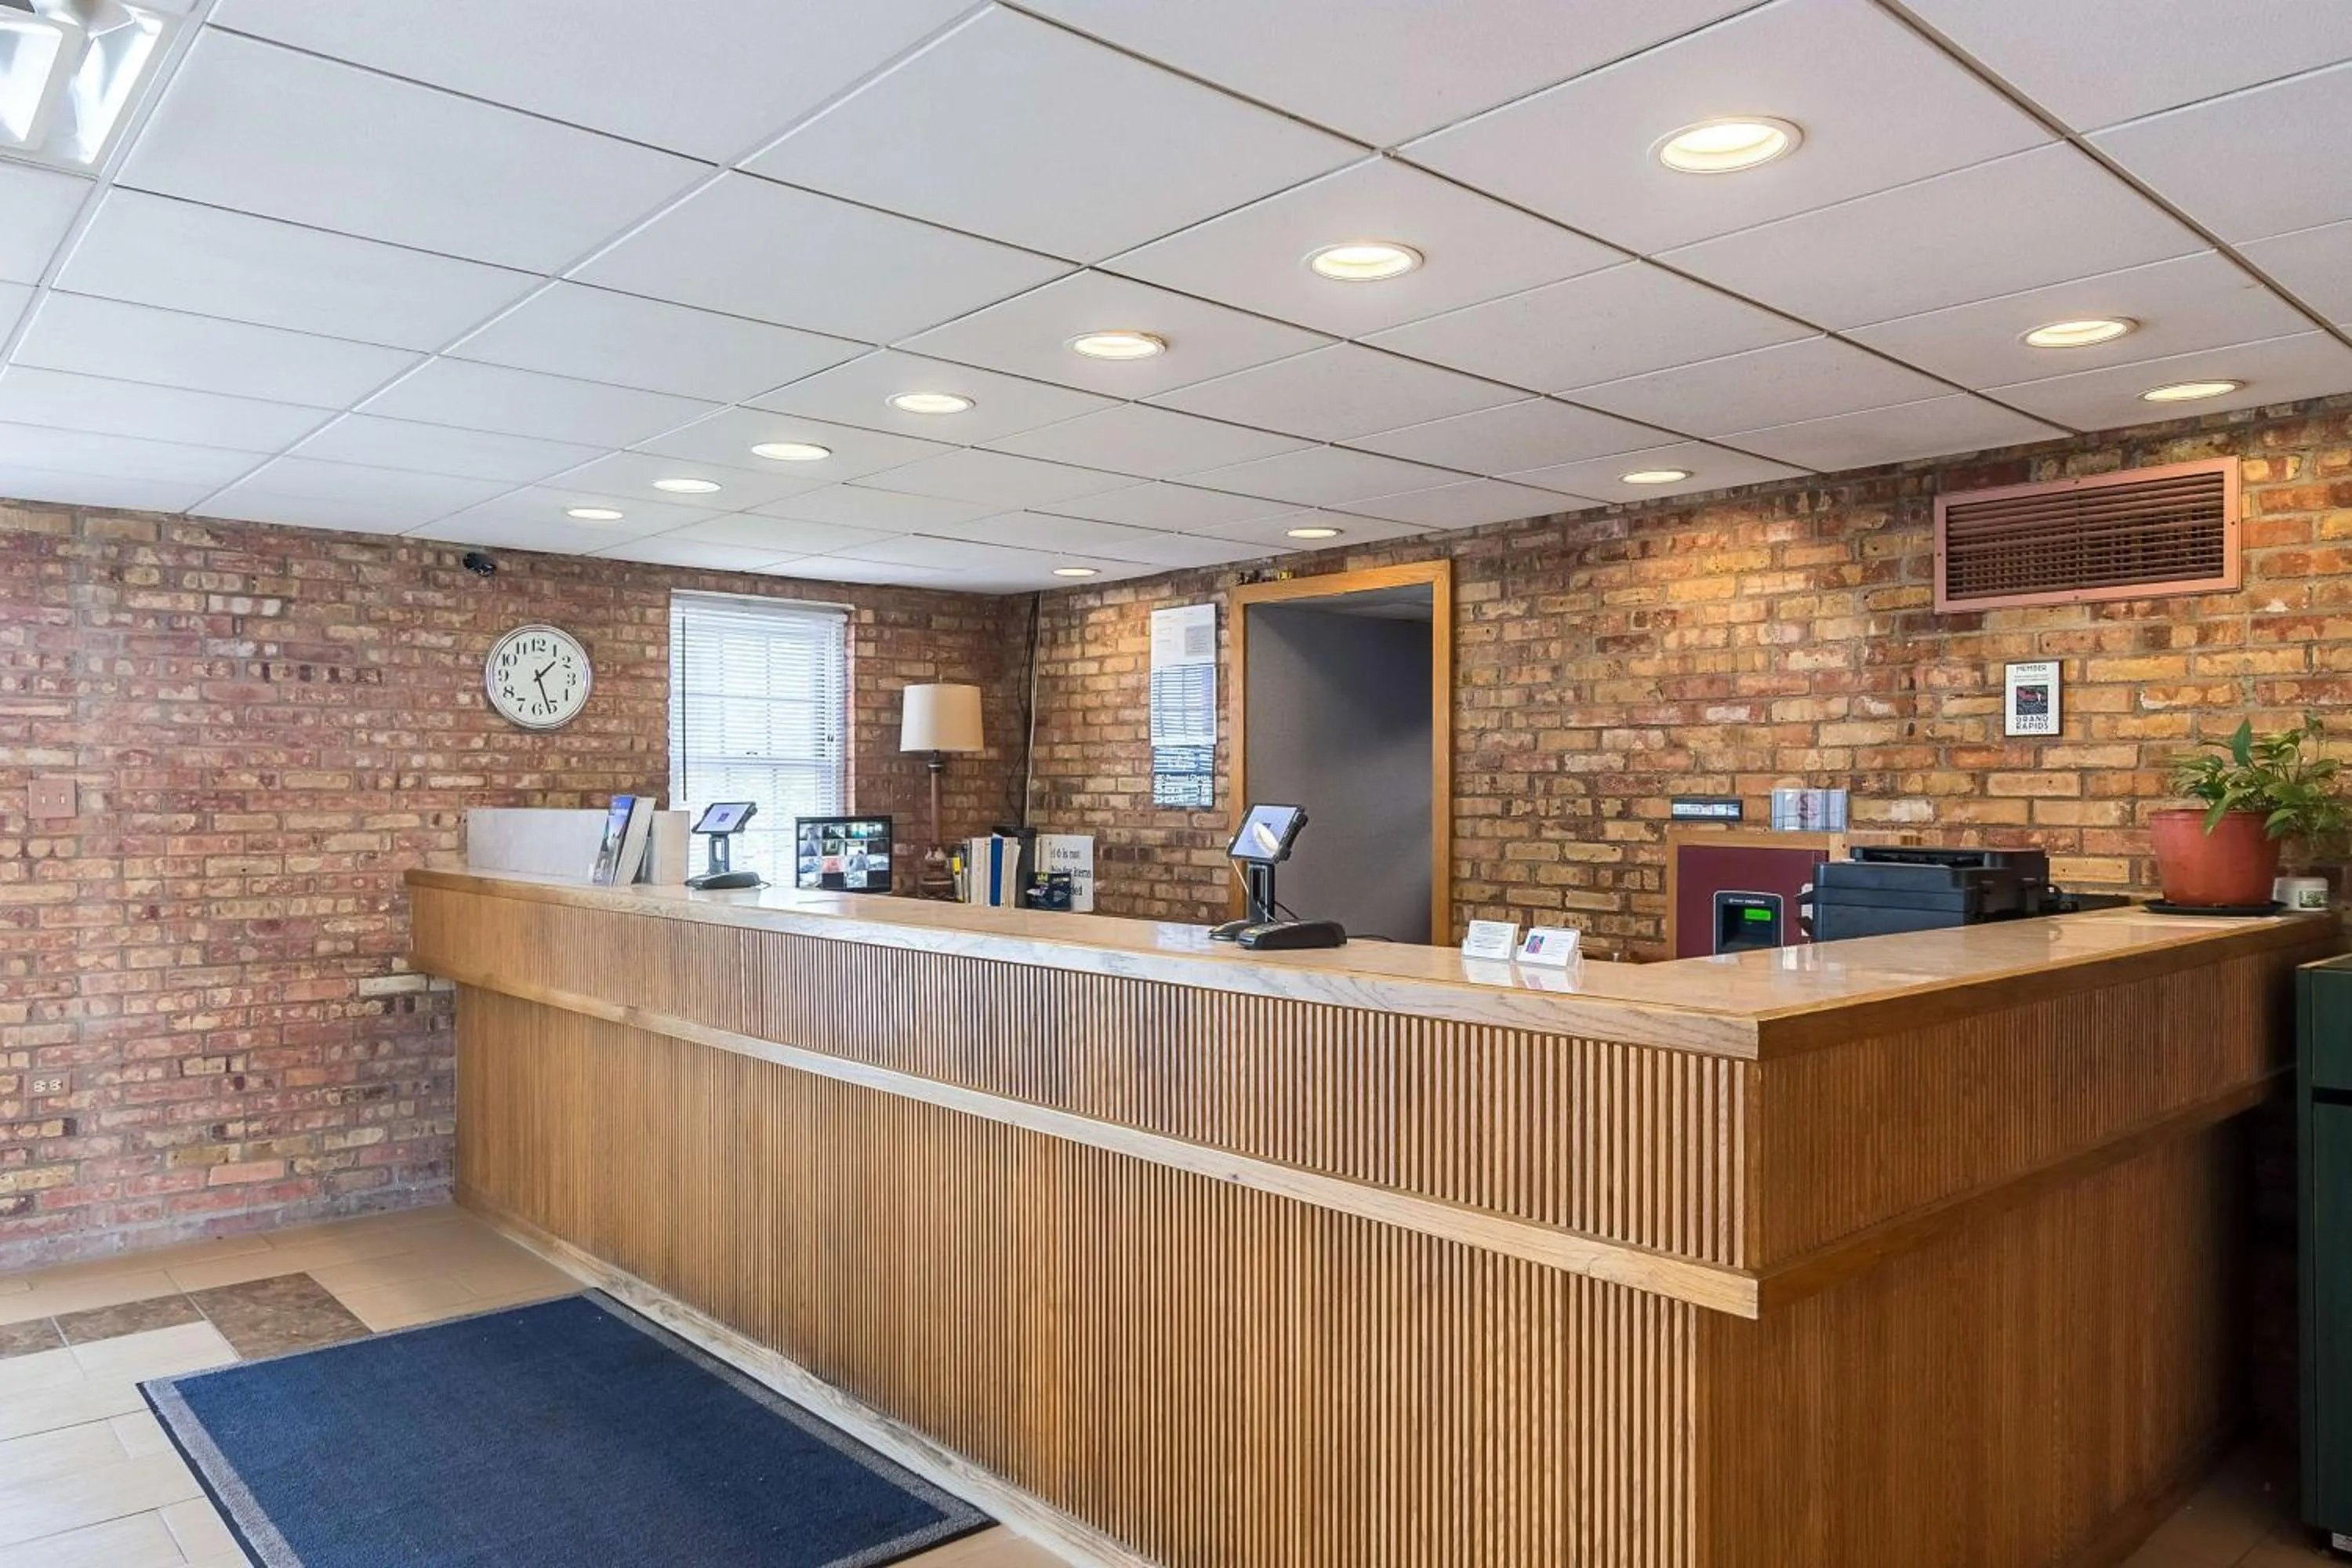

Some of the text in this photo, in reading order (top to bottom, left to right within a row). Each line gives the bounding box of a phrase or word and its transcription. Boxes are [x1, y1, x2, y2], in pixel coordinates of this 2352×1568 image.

[516, 641, 527, 655] 11
[531, 638, 546, 652] 12
[552, 644, 557, 657] 1
[503, 653, 517, 666] 10
[562, 655, 572, 669] 2
[498, 670, 509, 681] 9
[567, 673, 576, 686] 3
[503, 685, 514, 699] 8
[516, 697, 526, 713] 7
[531, 702, 543, 716] 6
